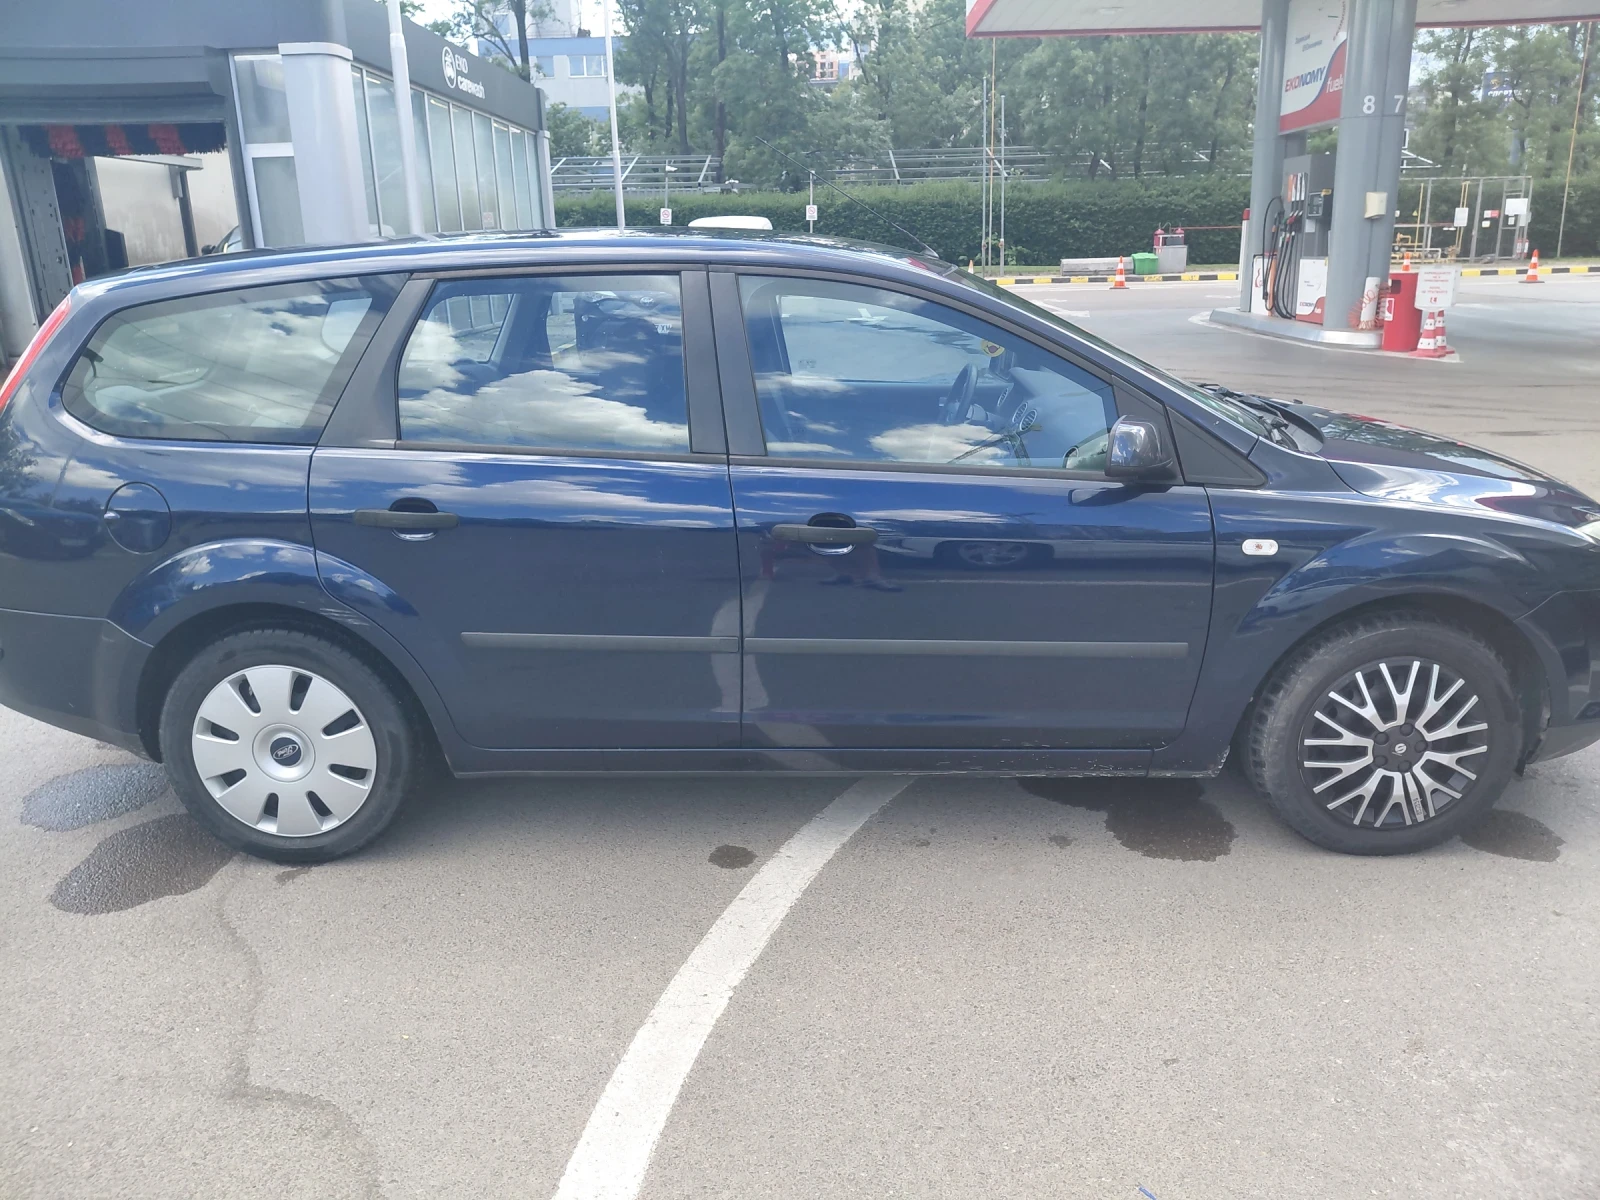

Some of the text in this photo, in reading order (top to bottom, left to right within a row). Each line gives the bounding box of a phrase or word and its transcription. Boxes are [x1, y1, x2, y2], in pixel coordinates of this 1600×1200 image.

[455, 54, 468, 74] EKO
[1285, 66, 1326, 92] EKONOMY
[1363, 95, 1404, 114] 8 7
